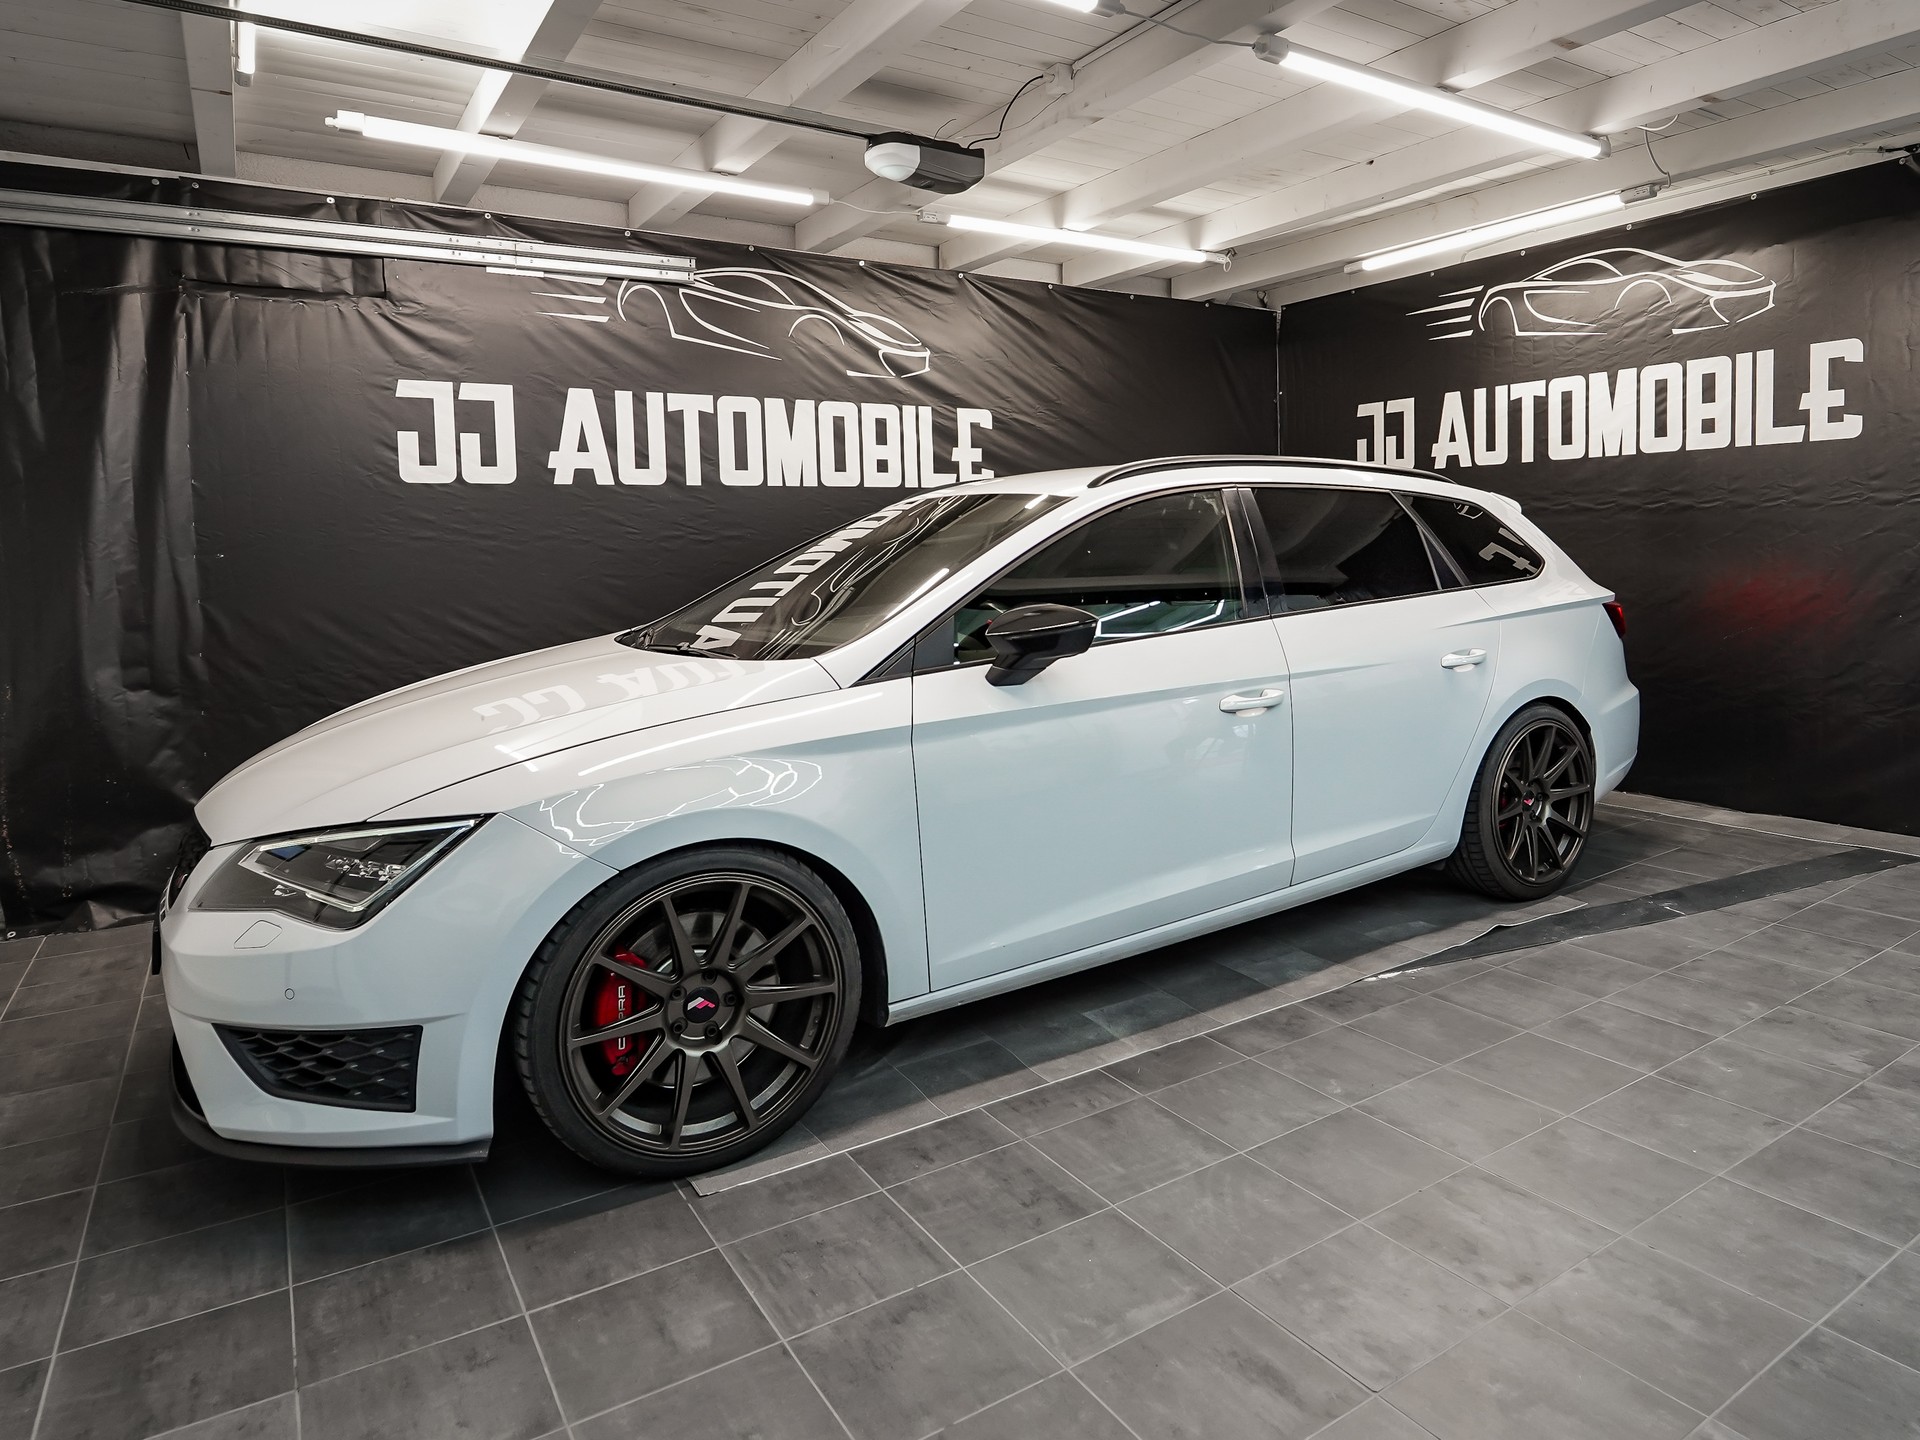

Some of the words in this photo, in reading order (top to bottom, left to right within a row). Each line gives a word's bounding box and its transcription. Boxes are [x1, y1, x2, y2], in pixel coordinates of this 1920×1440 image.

[395, 378, 517, 484] JJ
[547, 387, 995, 488] AUTOMOBILE
[1356, 397, 1415, 470] JJ
[1431, 337, 1864, 470] AUTOMOBILE
[618, 985, 626, 1050] CPRA
